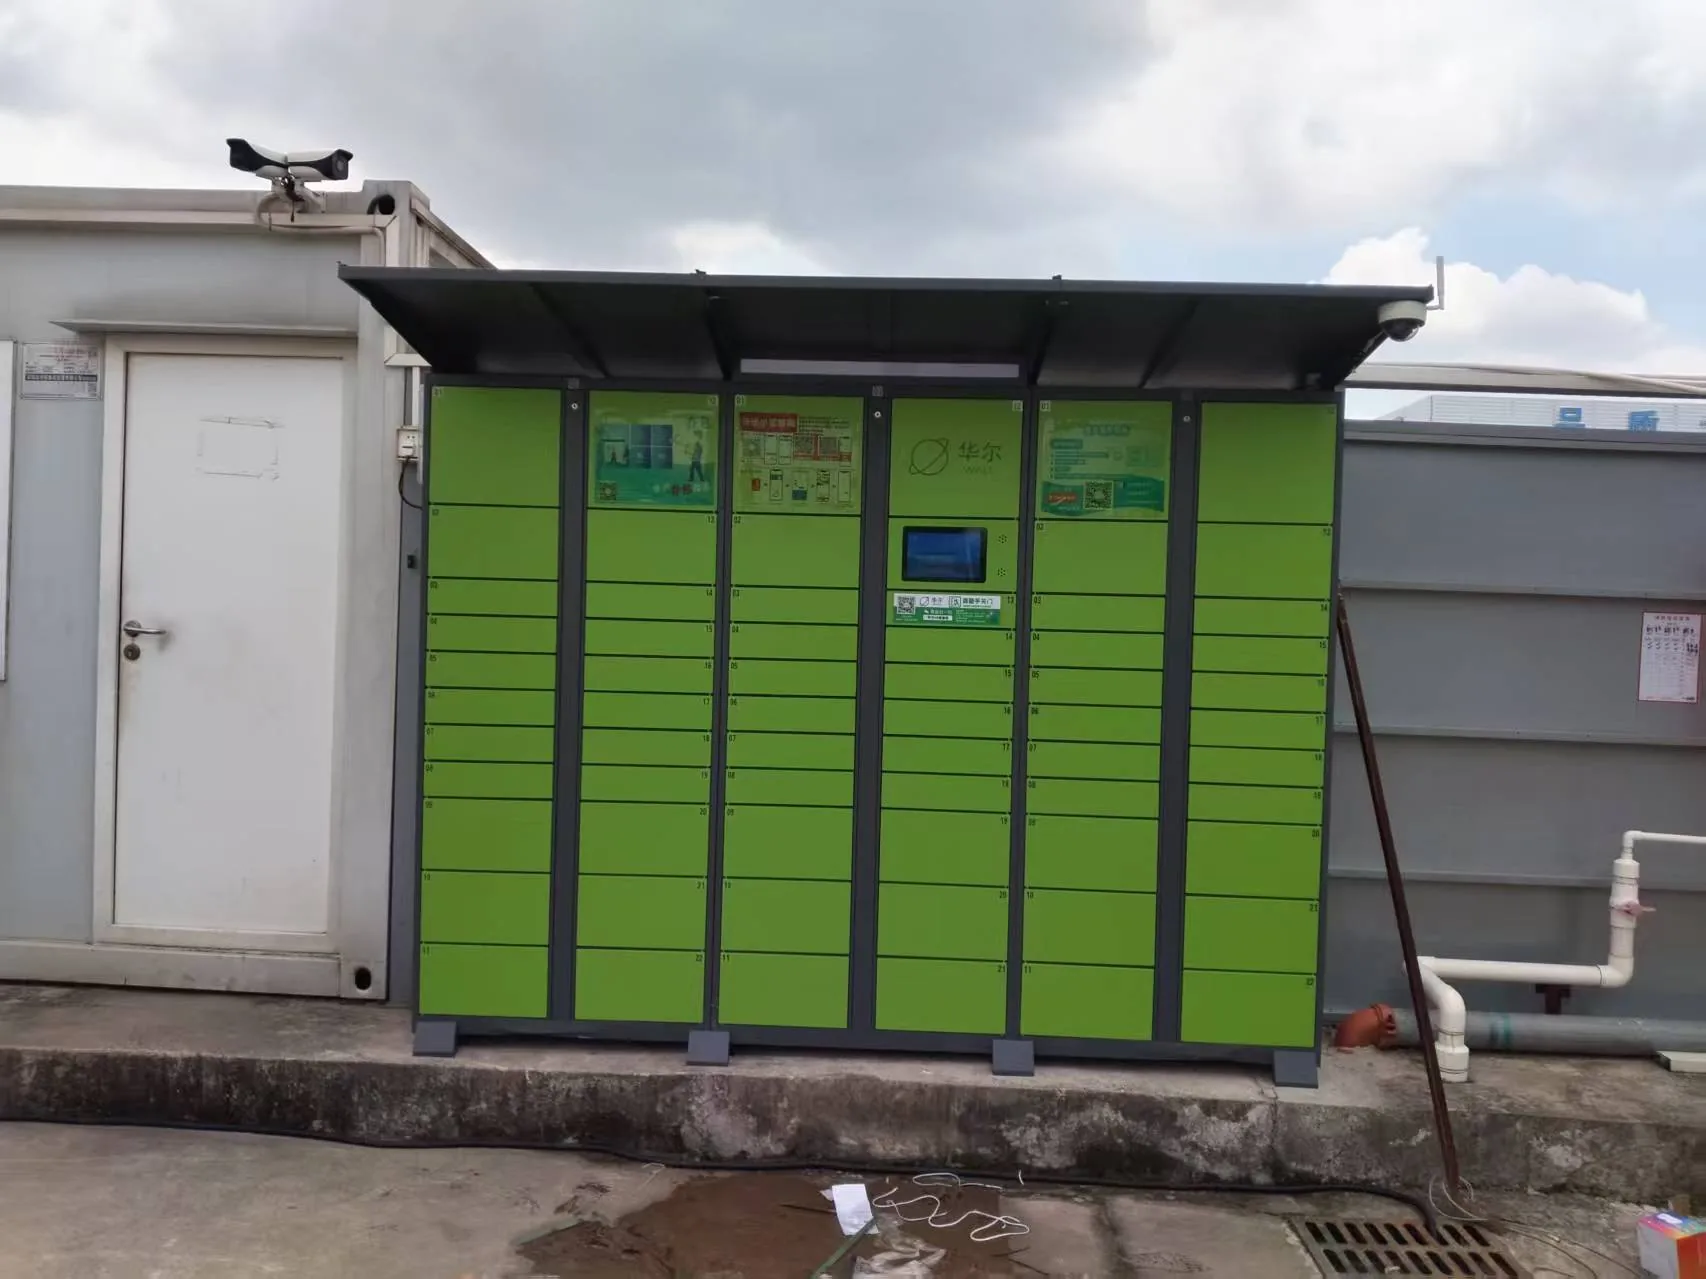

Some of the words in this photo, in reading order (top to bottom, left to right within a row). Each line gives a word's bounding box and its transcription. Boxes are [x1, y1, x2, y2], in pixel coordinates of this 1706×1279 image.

[958, 441, 1002, 463] 华尔
[1034, 596, 1041, 604] 03
[1029, 744, 1036, 752] 07
[1024, 966, 1031, 974] 11
